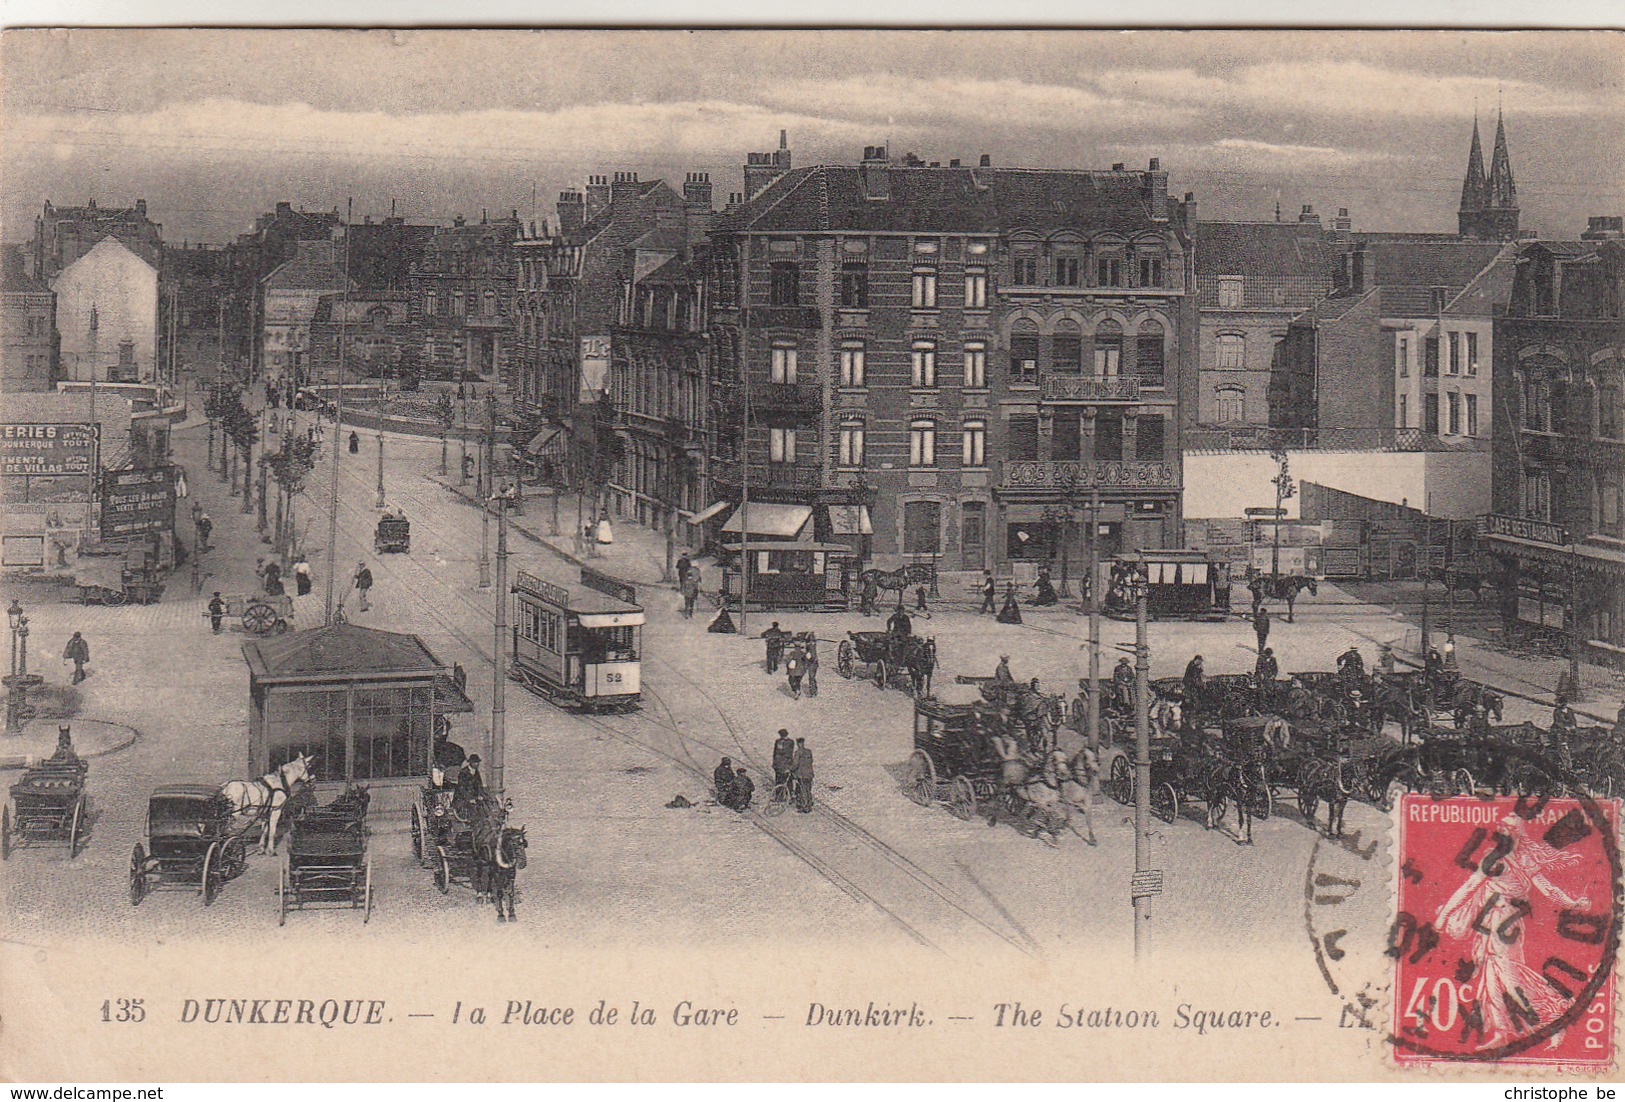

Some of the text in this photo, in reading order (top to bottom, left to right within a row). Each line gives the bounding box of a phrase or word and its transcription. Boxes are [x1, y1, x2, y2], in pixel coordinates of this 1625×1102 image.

[0, 426, 57, 438] ERIES
[24, 464, 63, 473] VILLAS
[606, 673, 622, 683] 52
